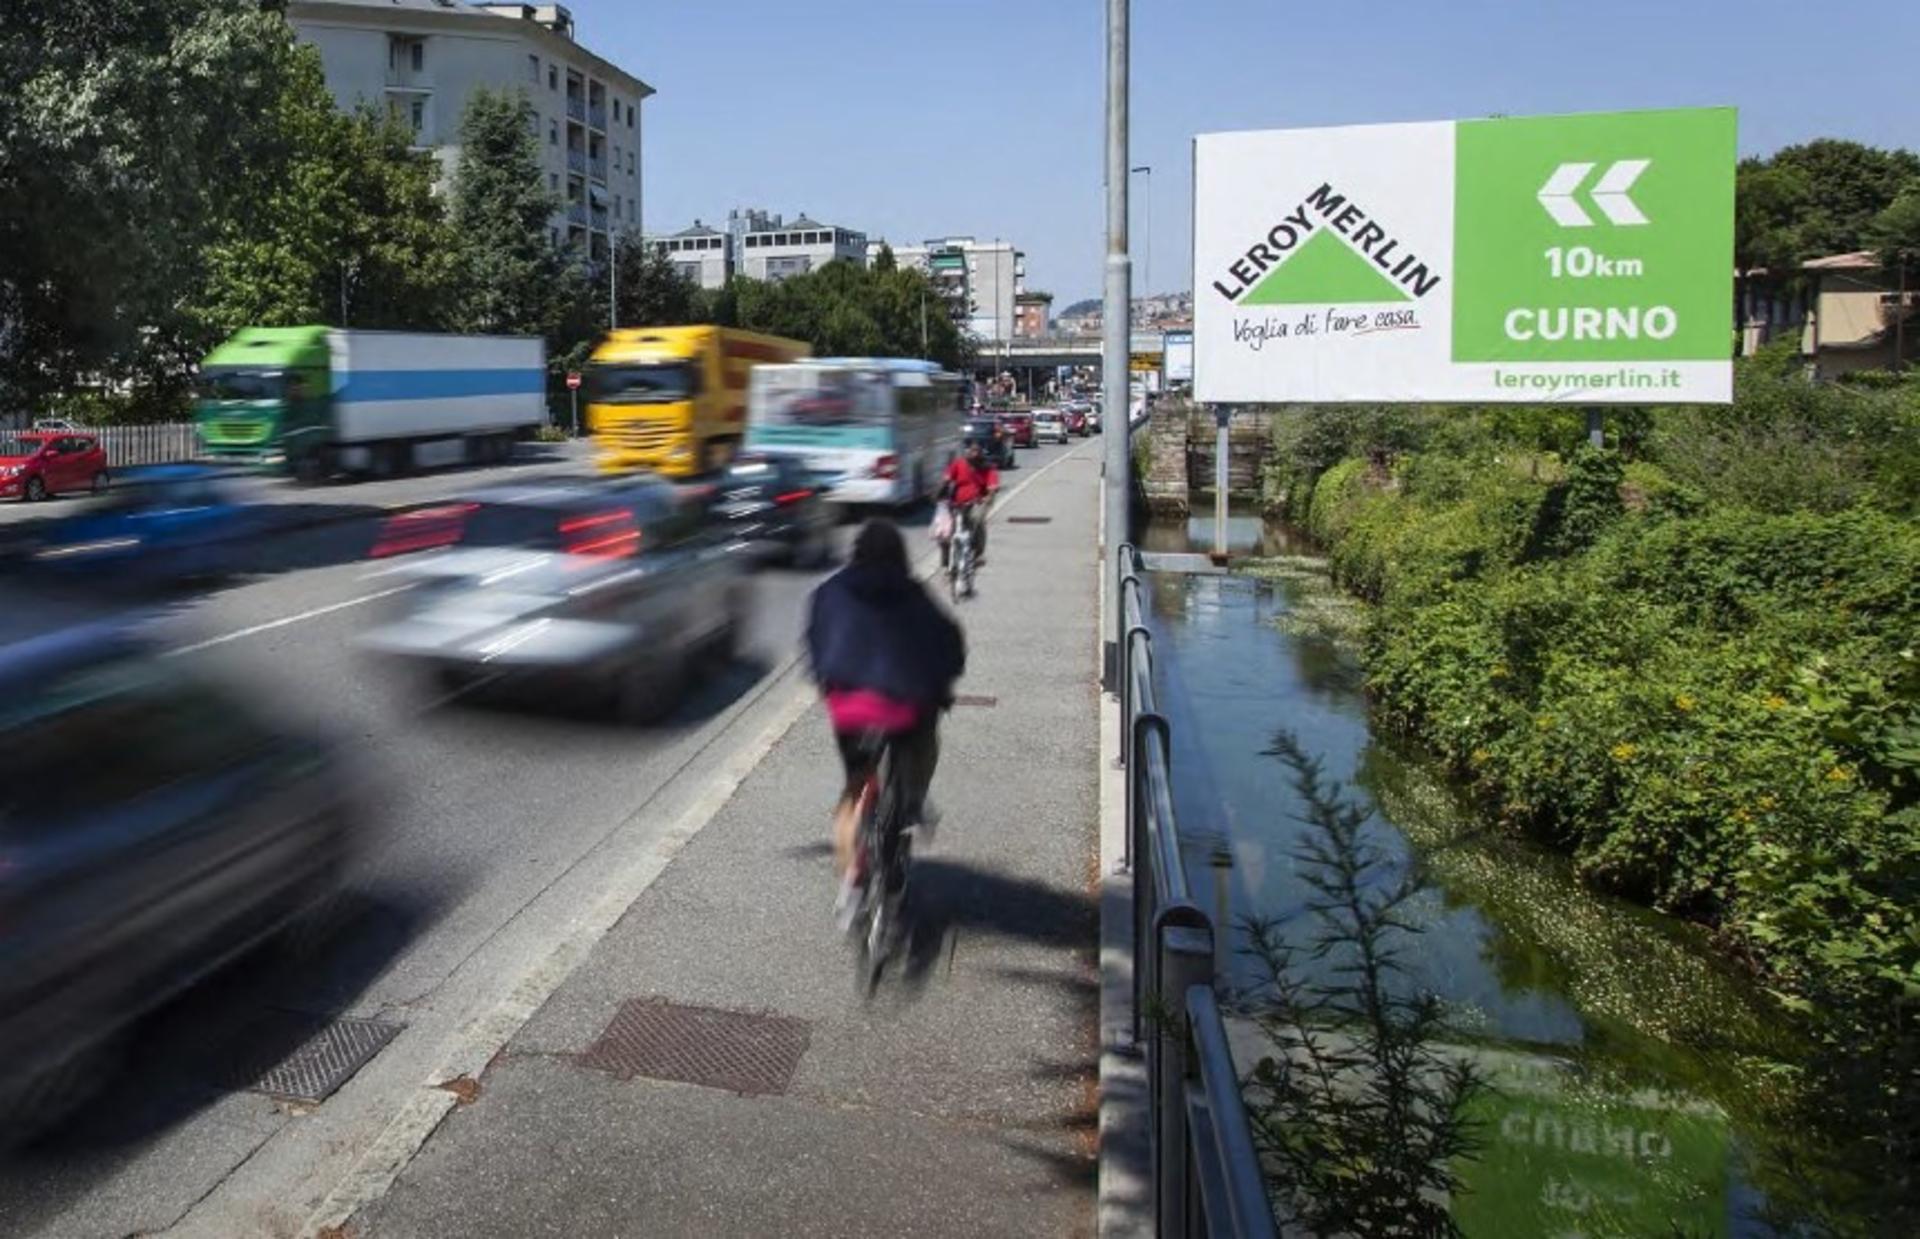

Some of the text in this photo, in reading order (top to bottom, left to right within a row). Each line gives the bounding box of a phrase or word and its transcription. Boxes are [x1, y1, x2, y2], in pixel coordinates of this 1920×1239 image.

[1213, 182, 1441, 301] LEROY MERLIN
[1544, 246, 1643, 278] 10km
[1233, 318, 1288, 351] Voglia
[1294, 313, 1318, 335] di
[1325, 309, 1367, 332] fare
[1505, 306, 1678, 340] CURNO
[1495, 369, 1681, 390] leroymerlin.it
